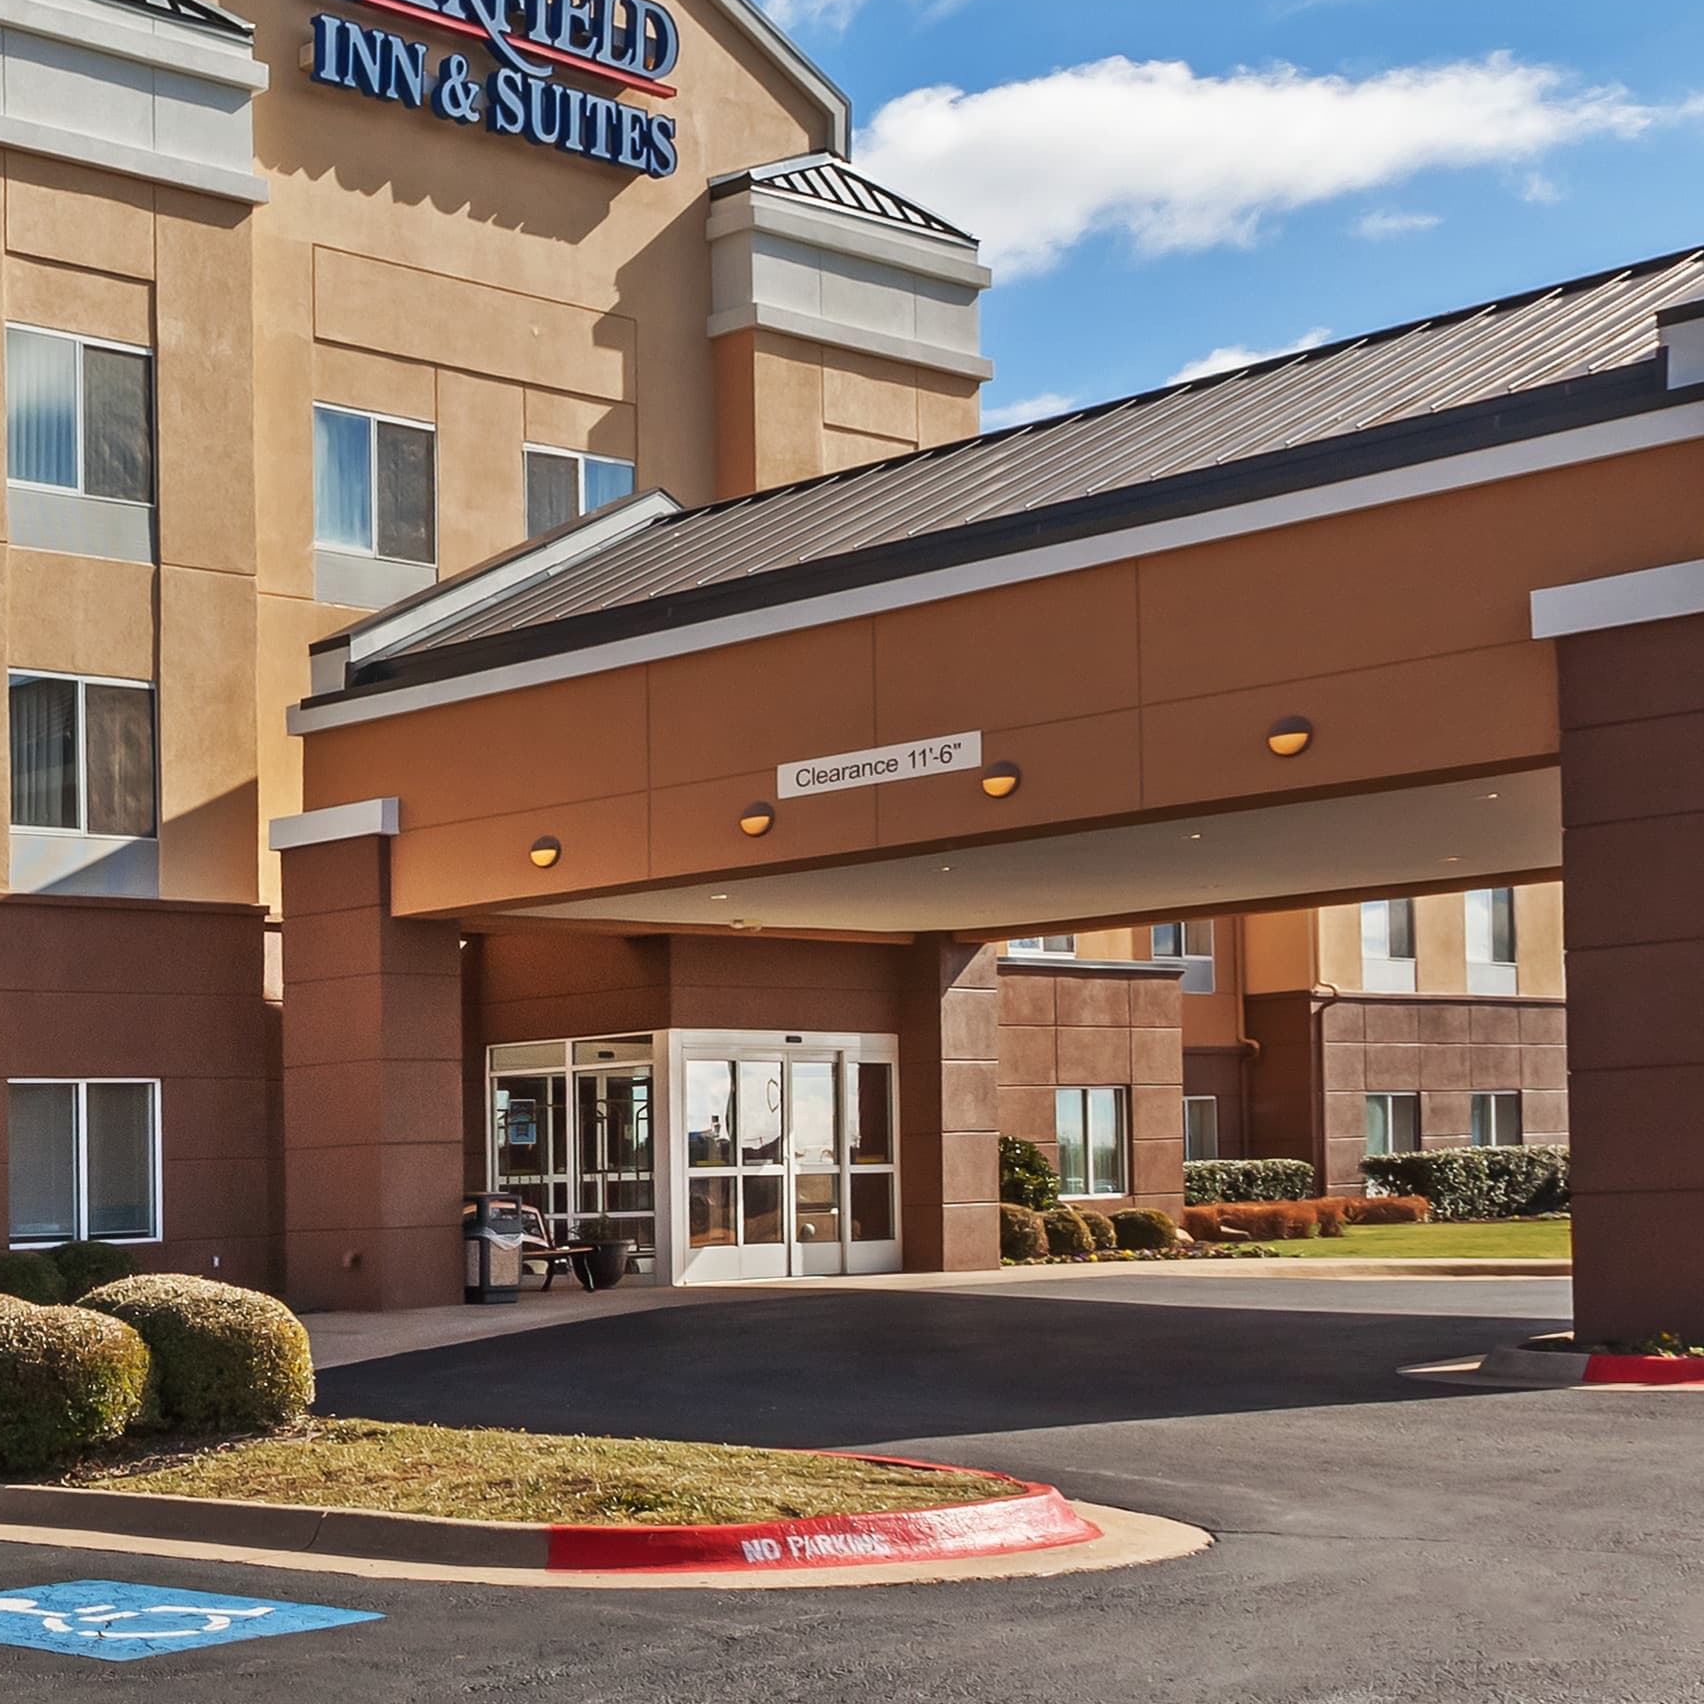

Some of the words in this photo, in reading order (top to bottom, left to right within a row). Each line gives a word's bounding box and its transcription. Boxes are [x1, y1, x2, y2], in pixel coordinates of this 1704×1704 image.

[311, 14, 429, 108] INN
[433, 53, 482, 123] &
[487, 65, 678, 178] SUITES
[795, 758, 899, 788] Clearance
[907, 742, 962, 769] 11'-6"
[741, 1538, 781, 1563] NO
[787, 1533, 891, 1559] PARKING
